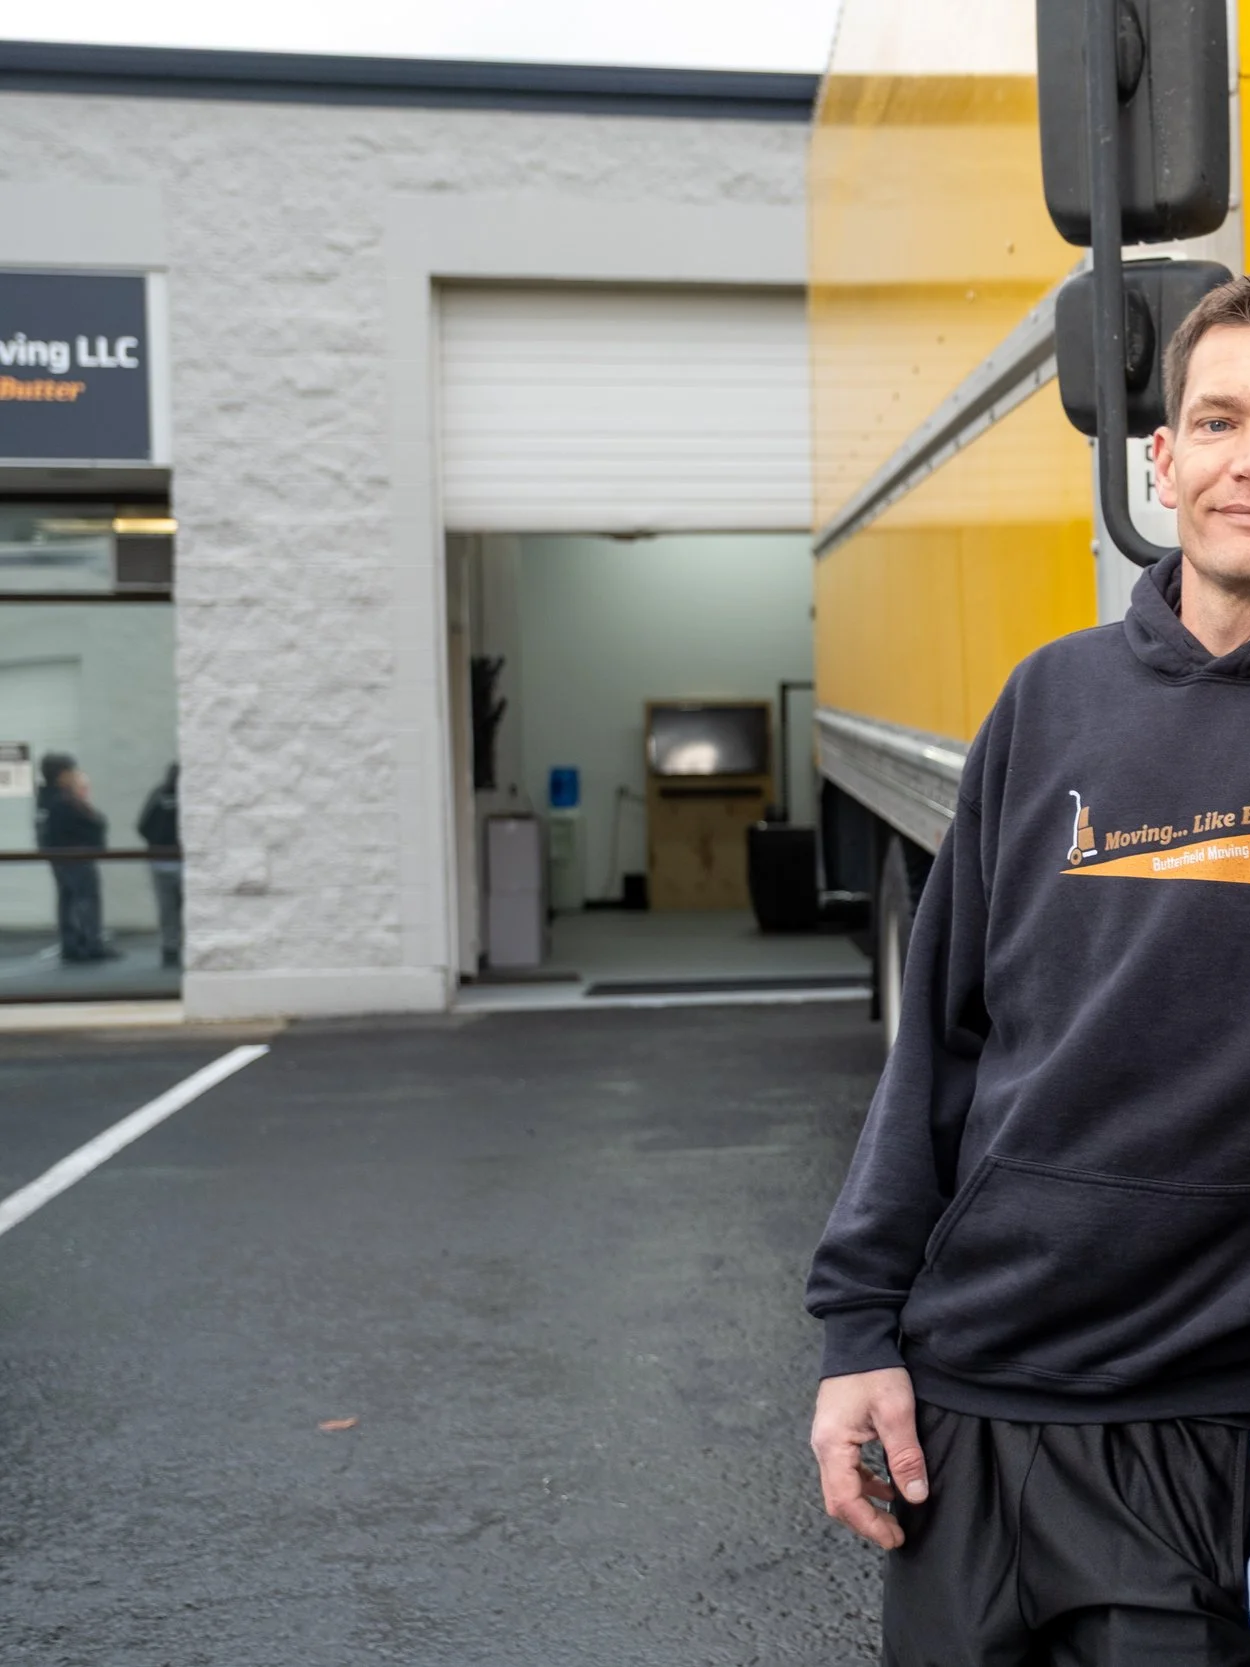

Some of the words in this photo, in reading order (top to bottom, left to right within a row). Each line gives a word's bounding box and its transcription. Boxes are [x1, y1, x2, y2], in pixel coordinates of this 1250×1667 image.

[76, 336, 139, 368] LLC
[1105, 825, 1187, 850] Moving...
[1192, 811, 1236, 834] Like
[1152, 852, 1204, 871] Butterfield
[1207, 844, 1249, 861] Moving
